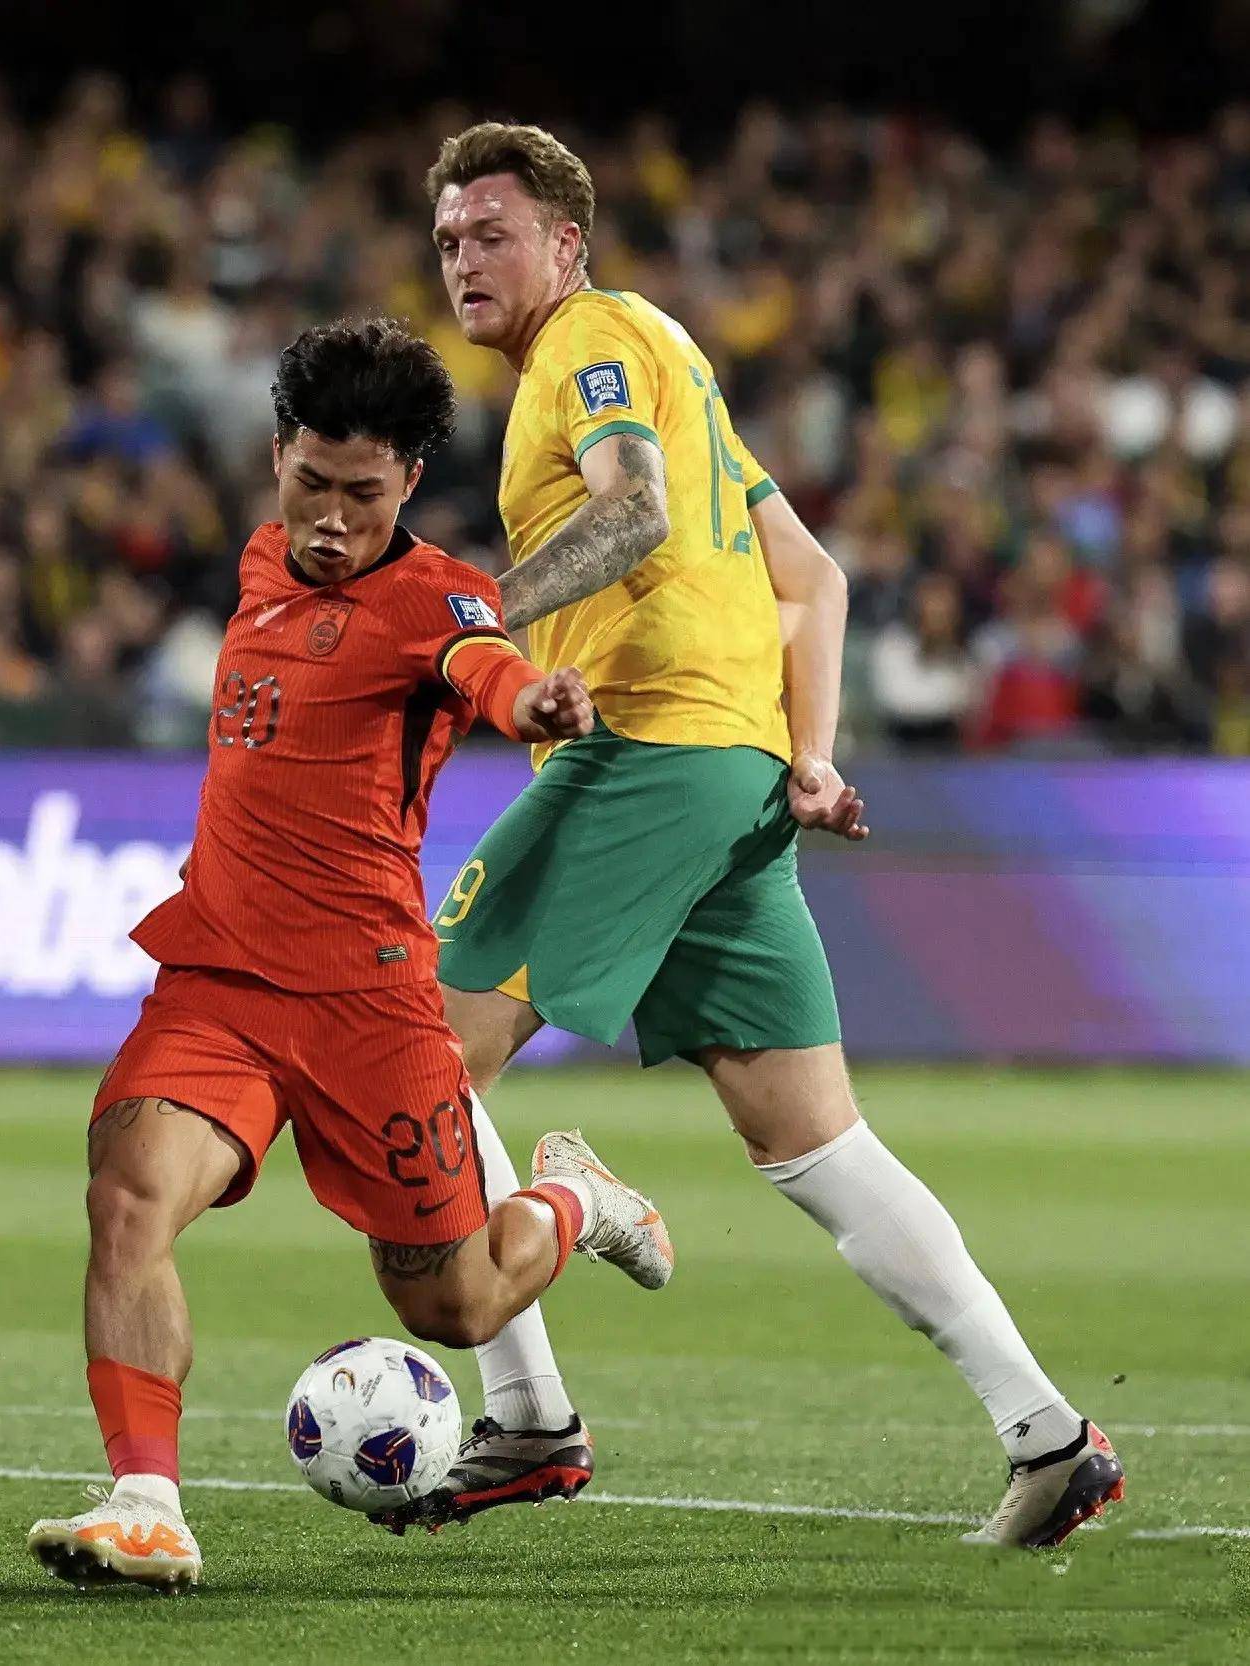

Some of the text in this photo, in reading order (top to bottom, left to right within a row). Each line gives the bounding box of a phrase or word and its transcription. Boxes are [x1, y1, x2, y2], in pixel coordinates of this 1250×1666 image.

[588, 375, 618, 390] UNITES
[216, 670, 281, 749] 20
[381, 1100, 467, 1188] 20
